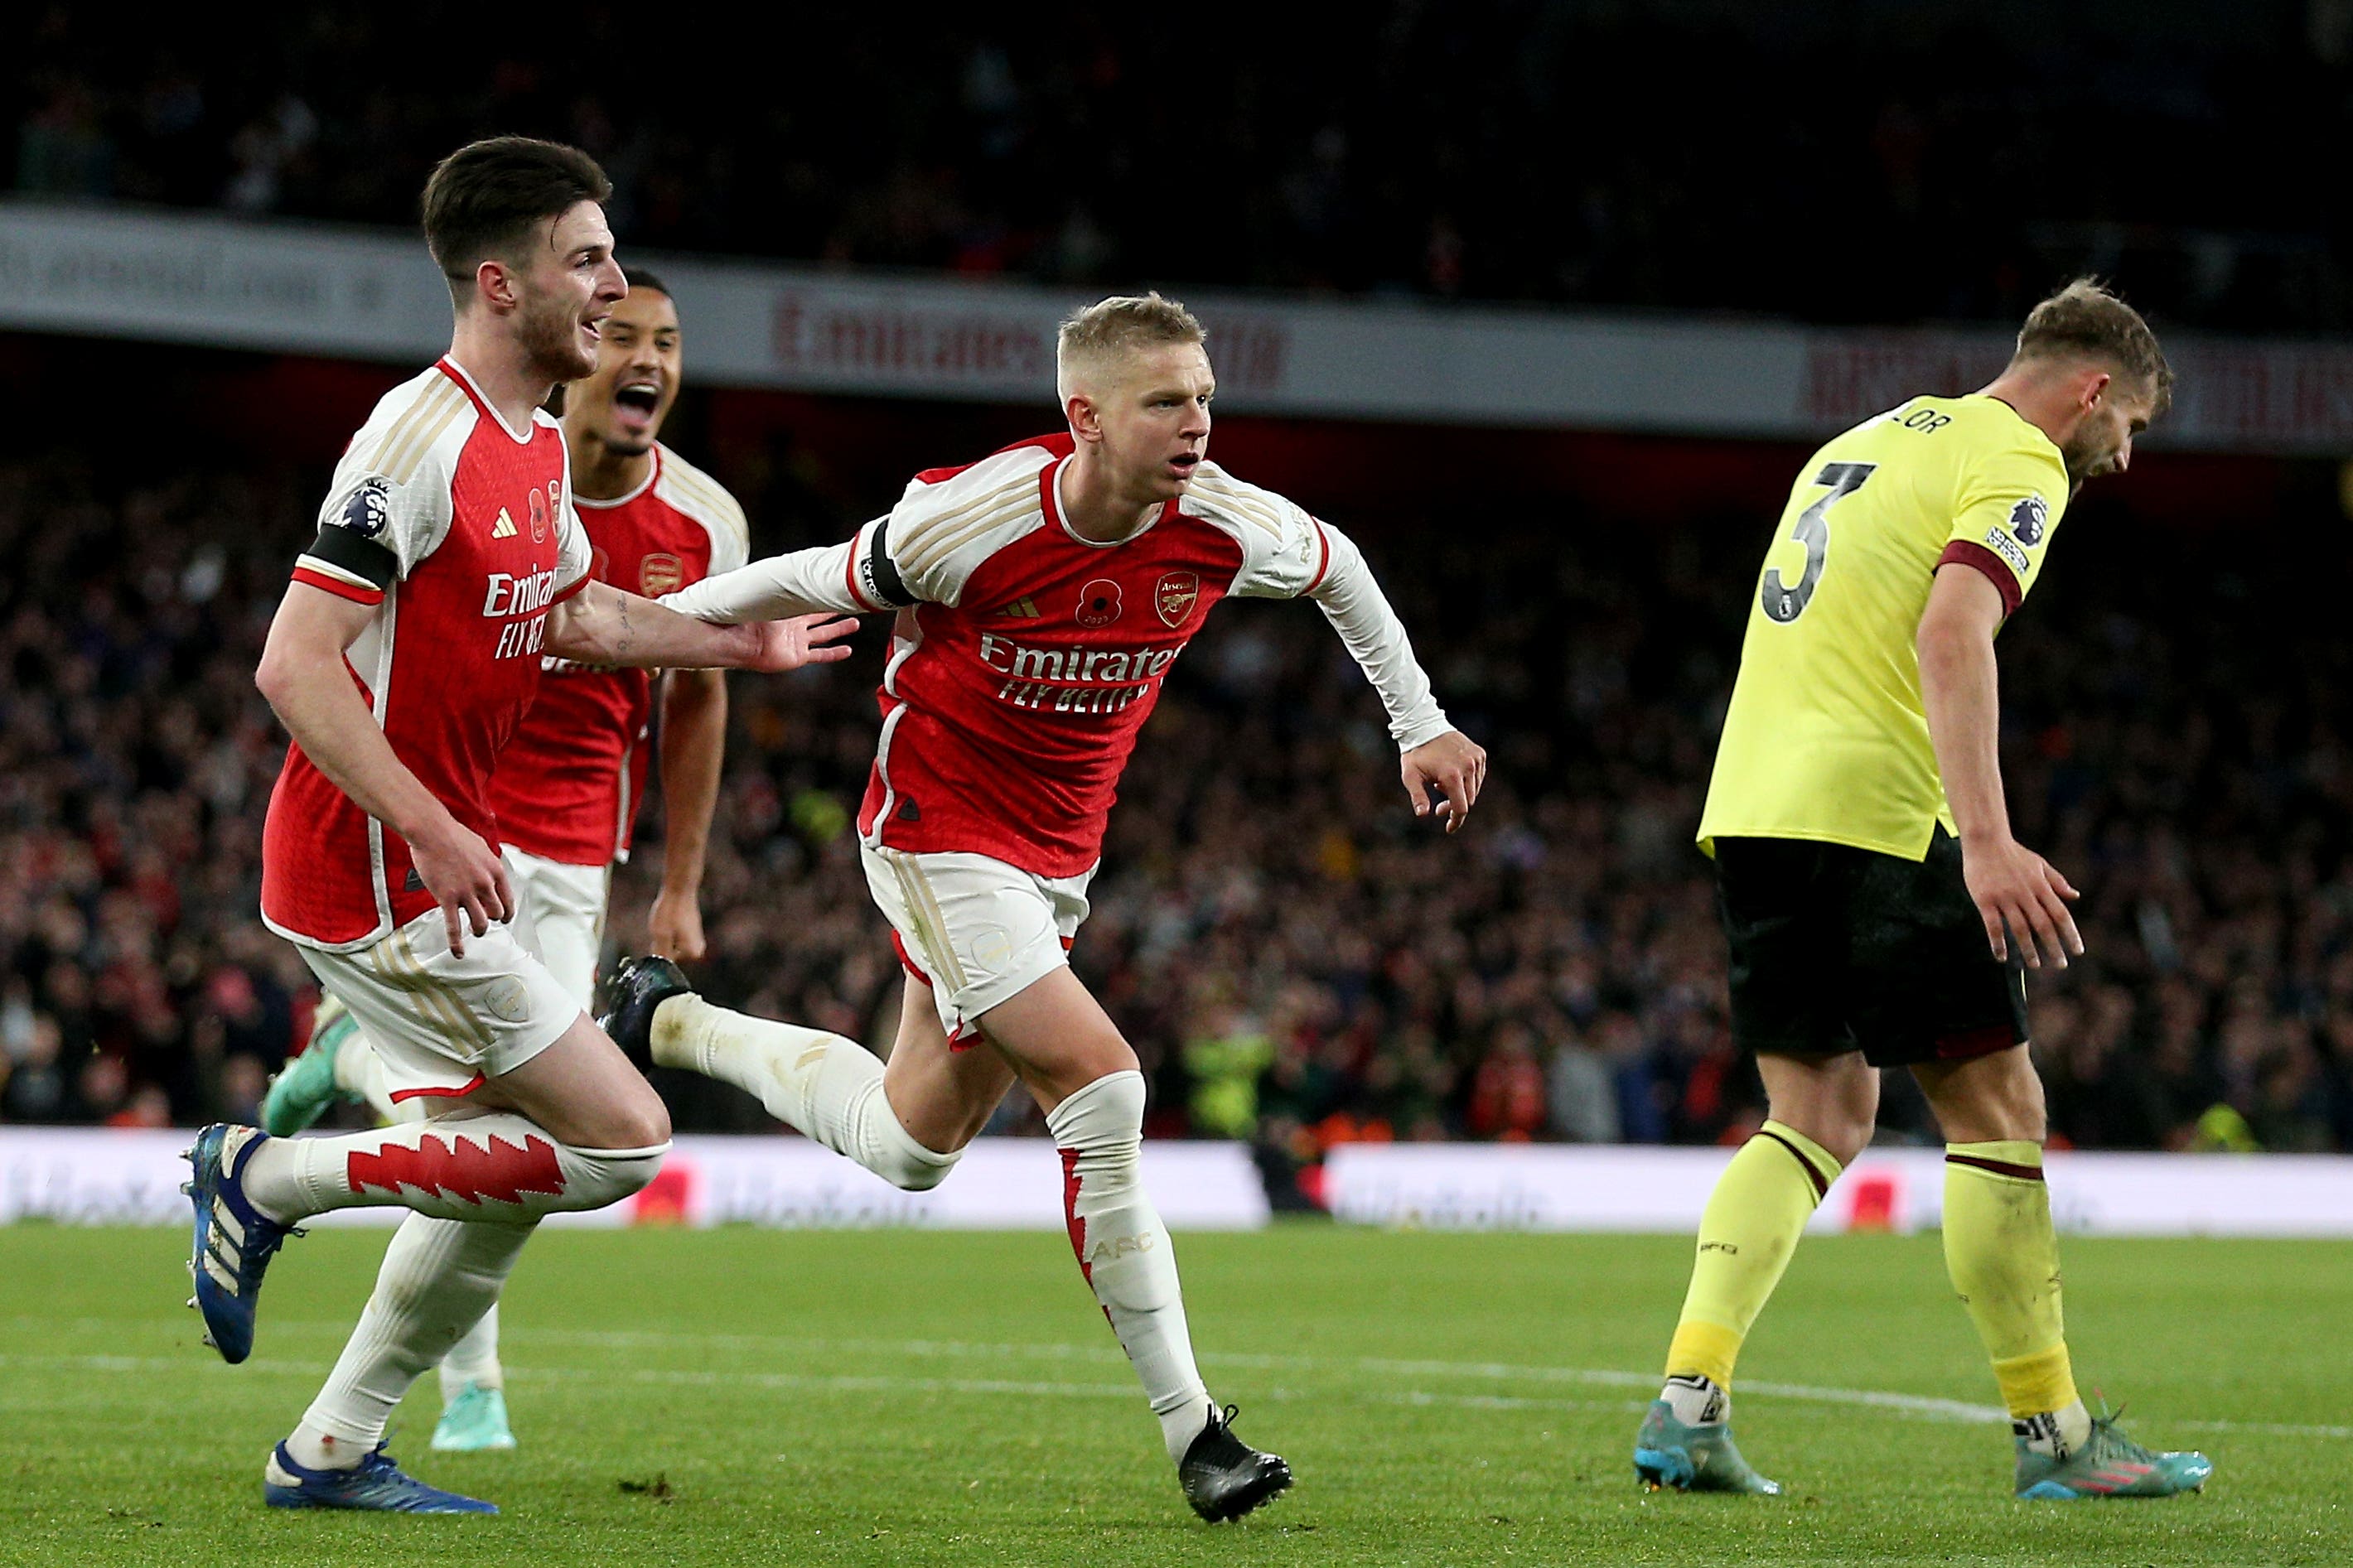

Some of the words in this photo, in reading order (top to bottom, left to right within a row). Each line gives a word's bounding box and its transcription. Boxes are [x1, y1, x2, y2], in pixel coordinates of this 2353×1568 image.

[1761, 462, 1879, 624] 3
[495, 620, 529, 659] FLY
[998, 678, 1054, 709] FLY
[1091, 1231, 1155, 1260] AFC
